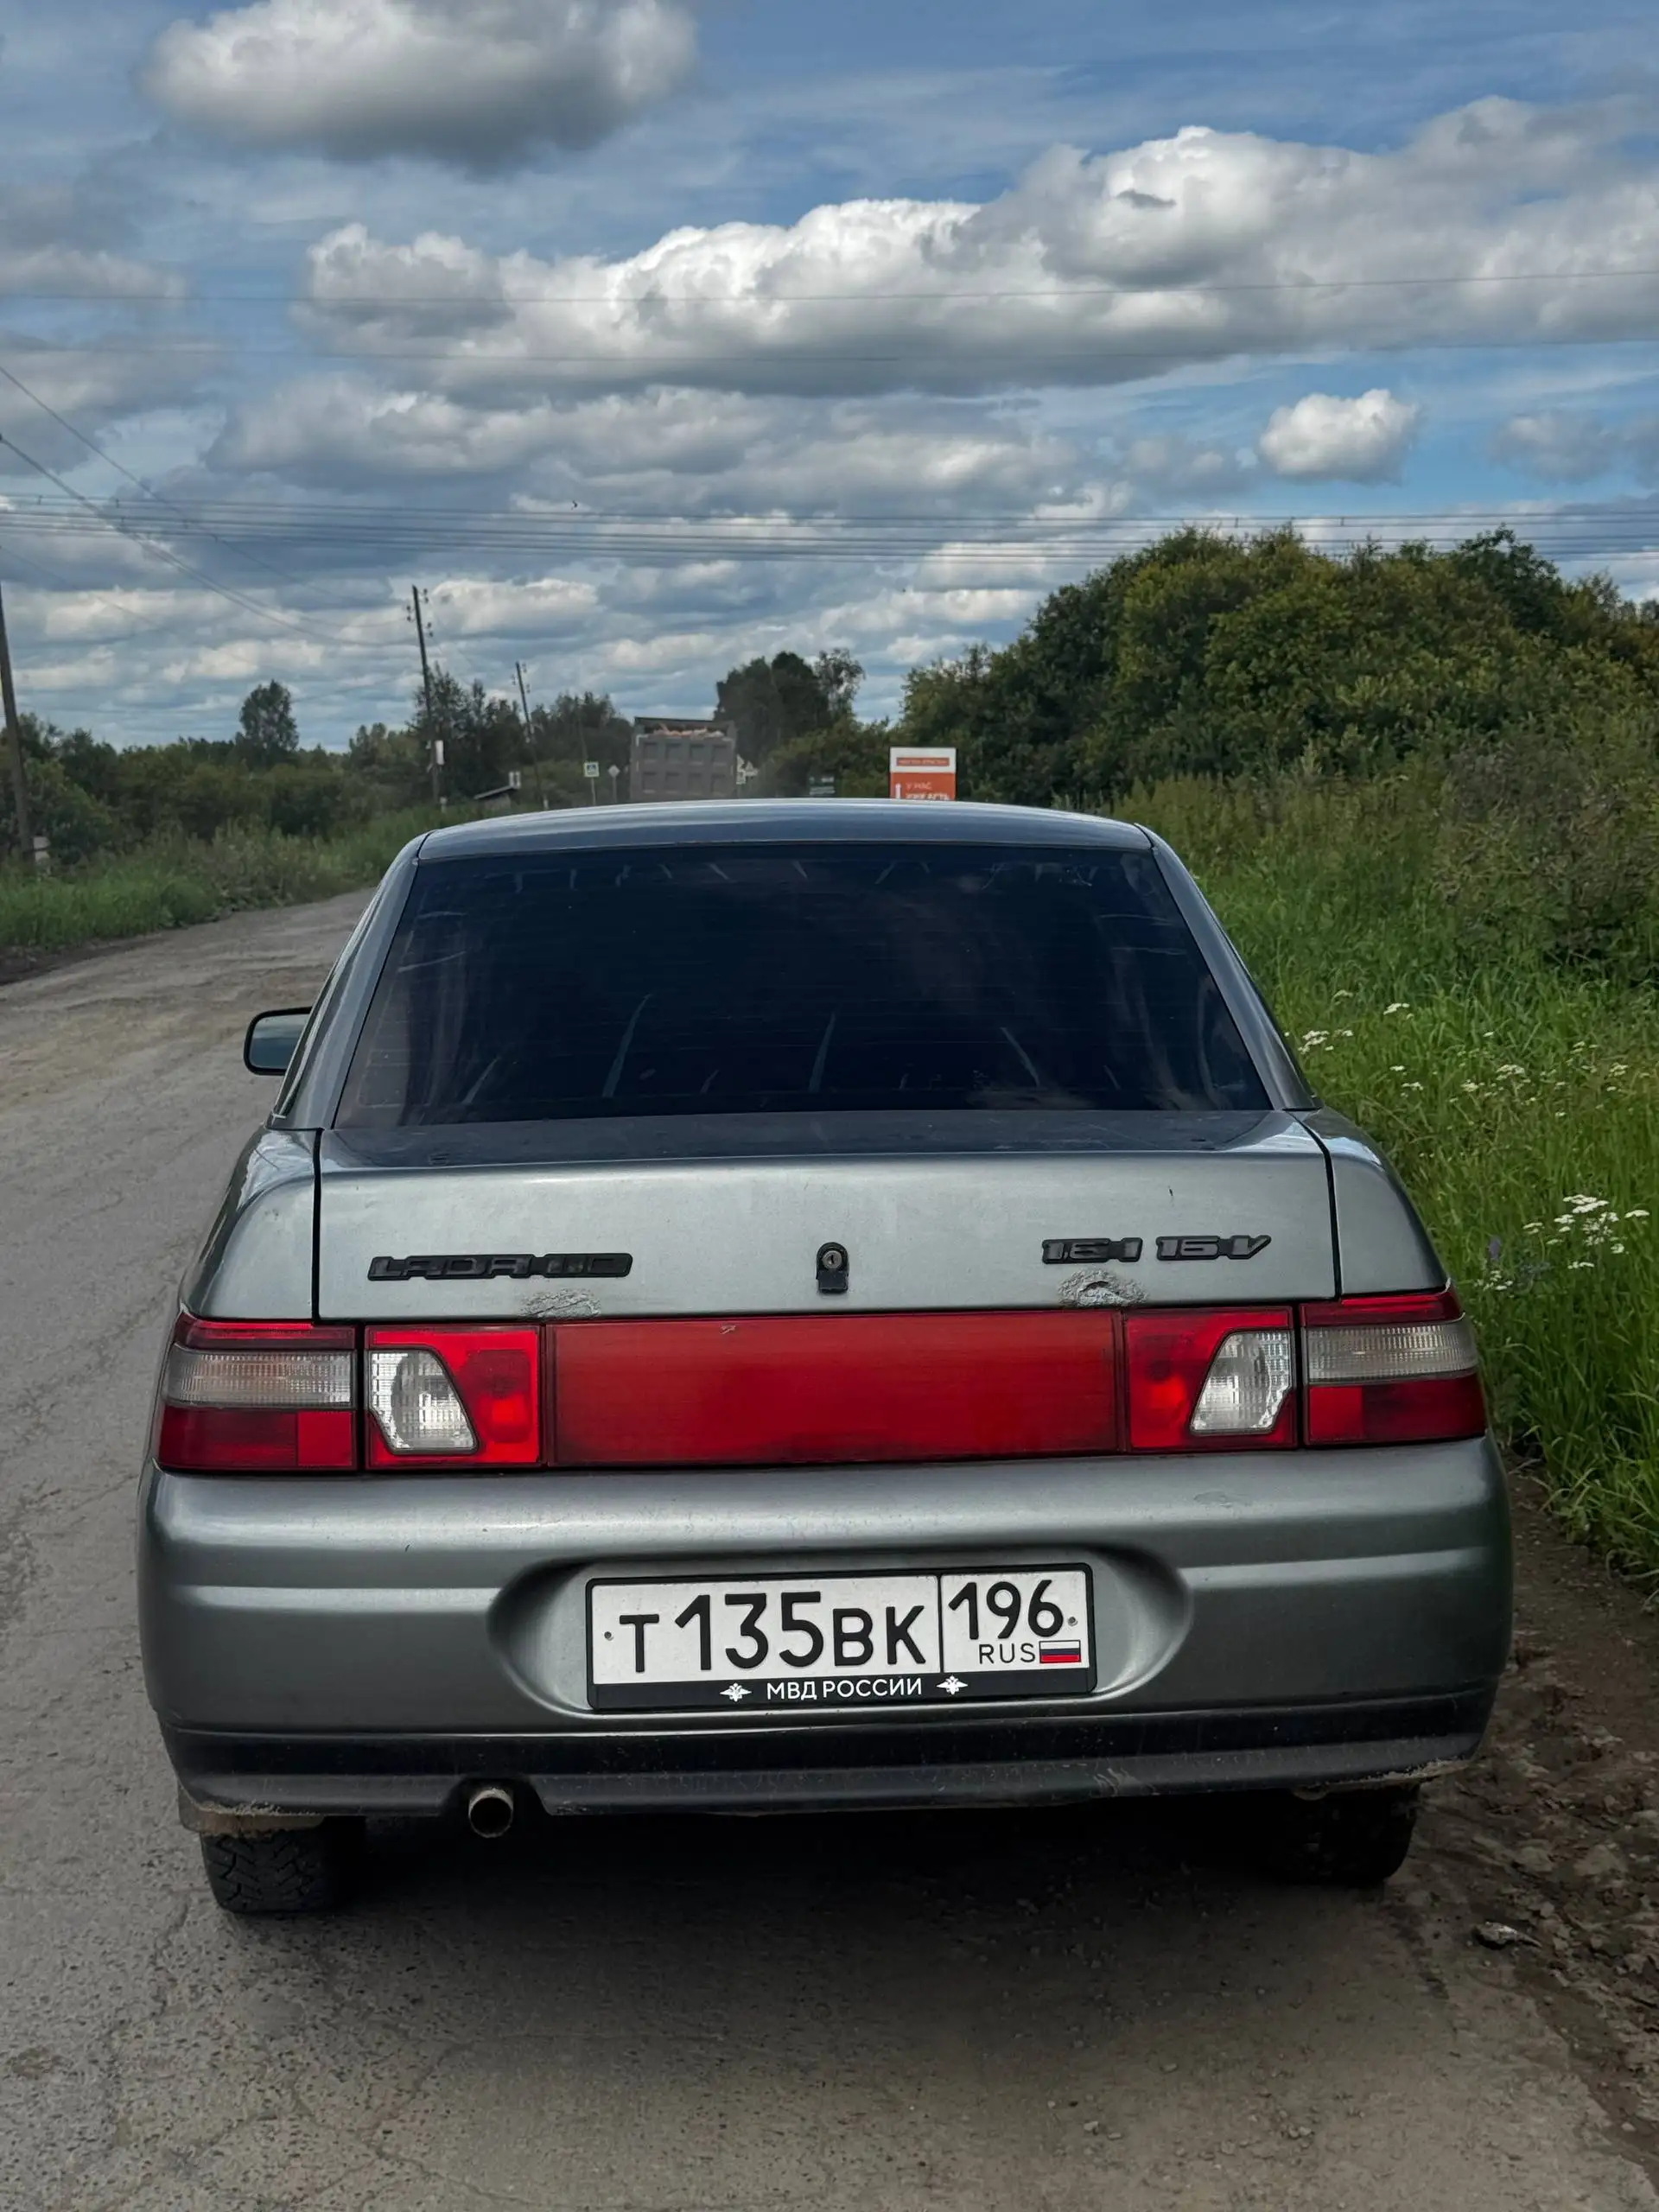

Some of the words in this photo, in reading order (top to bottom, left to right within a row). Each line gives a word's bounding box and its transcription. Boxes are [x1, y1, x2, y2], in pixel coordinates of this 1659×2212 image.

[1156, 1235, 1271, 1261] 16V
[368, 1255, 533, 1281] LADA
[948, 1580, 1064, 1640] 196
[979, 1643, 1035, 1665] RUS
[766, 1681, 817, 1700] МВД
[823, 1678, 922, 1698] РОССИИ
